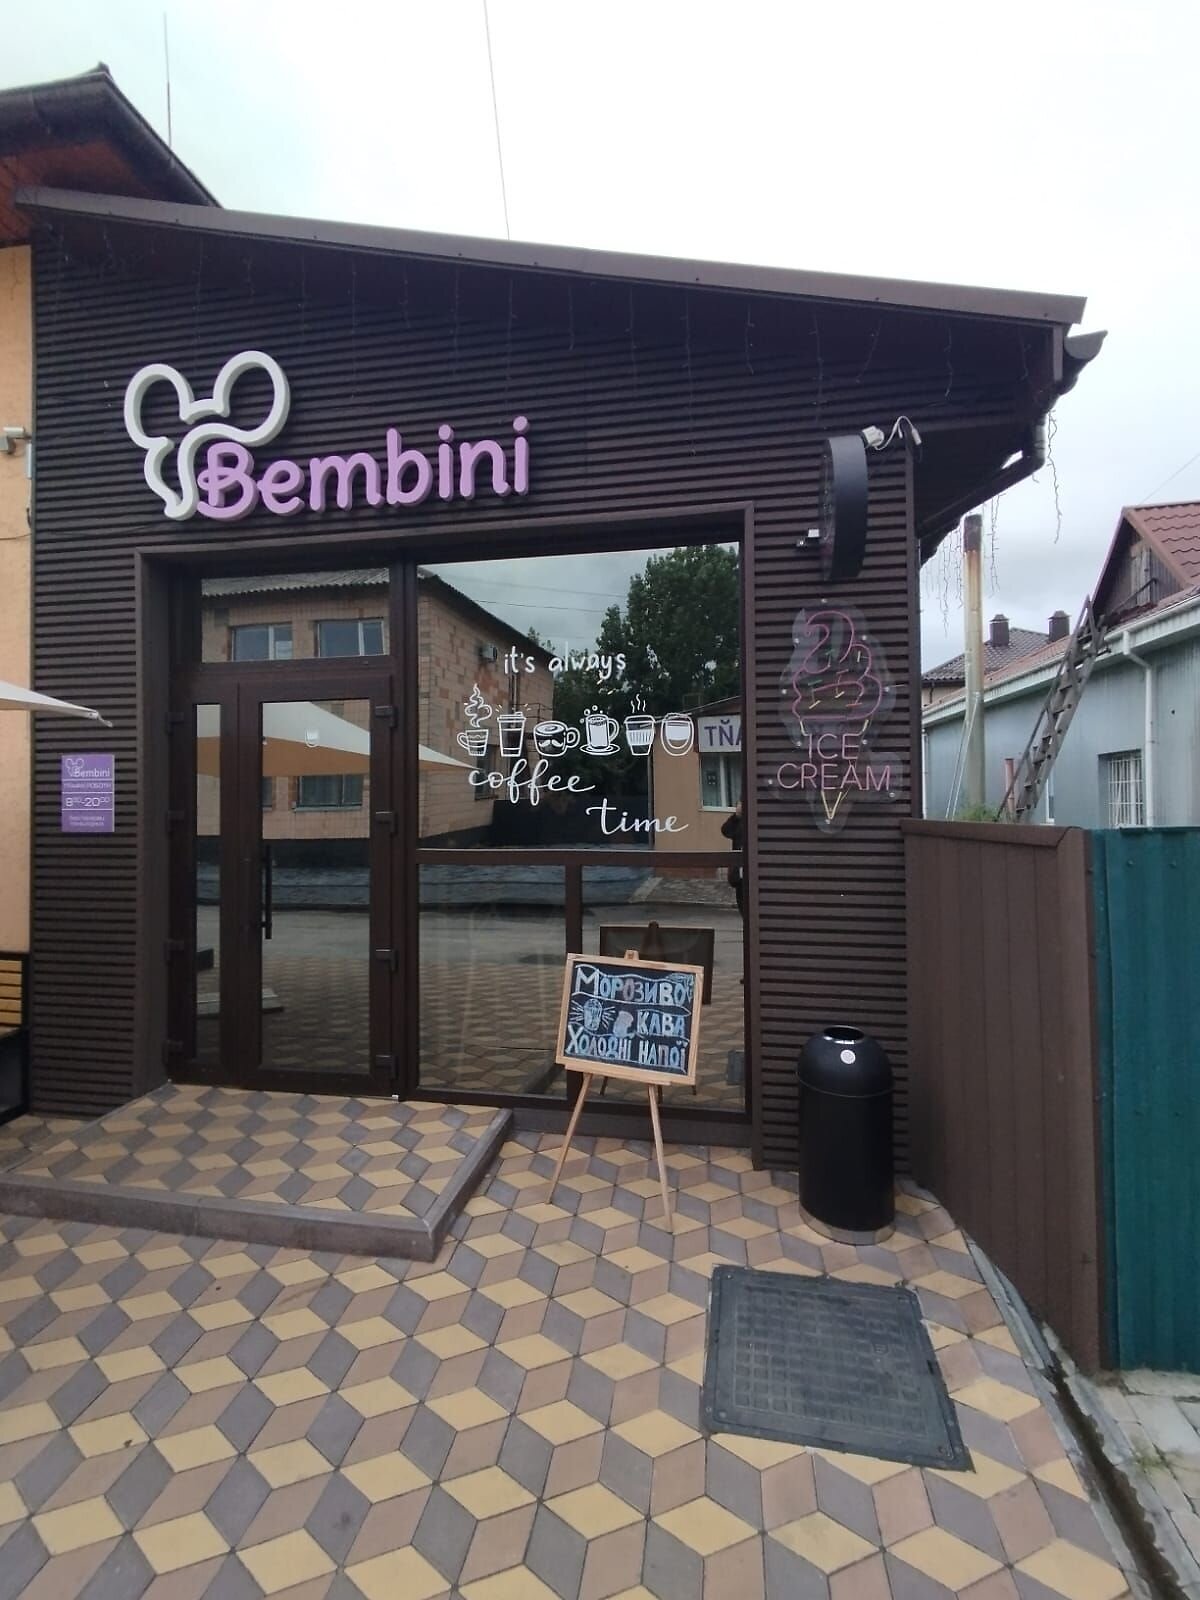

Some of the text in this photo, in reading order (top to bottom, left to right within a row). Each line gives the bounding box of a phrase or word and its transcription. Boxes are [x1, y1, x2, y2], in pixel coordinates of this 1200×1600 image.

[196, 416, 530, 521] Bembini
[504, 642, 627, 680] it's always
[808, 733, 860, 760] ICE
[468, 758, 596, 807] coffee
[777, 762, 891, 792] CREAM
[585, 798, 689, 836] time
